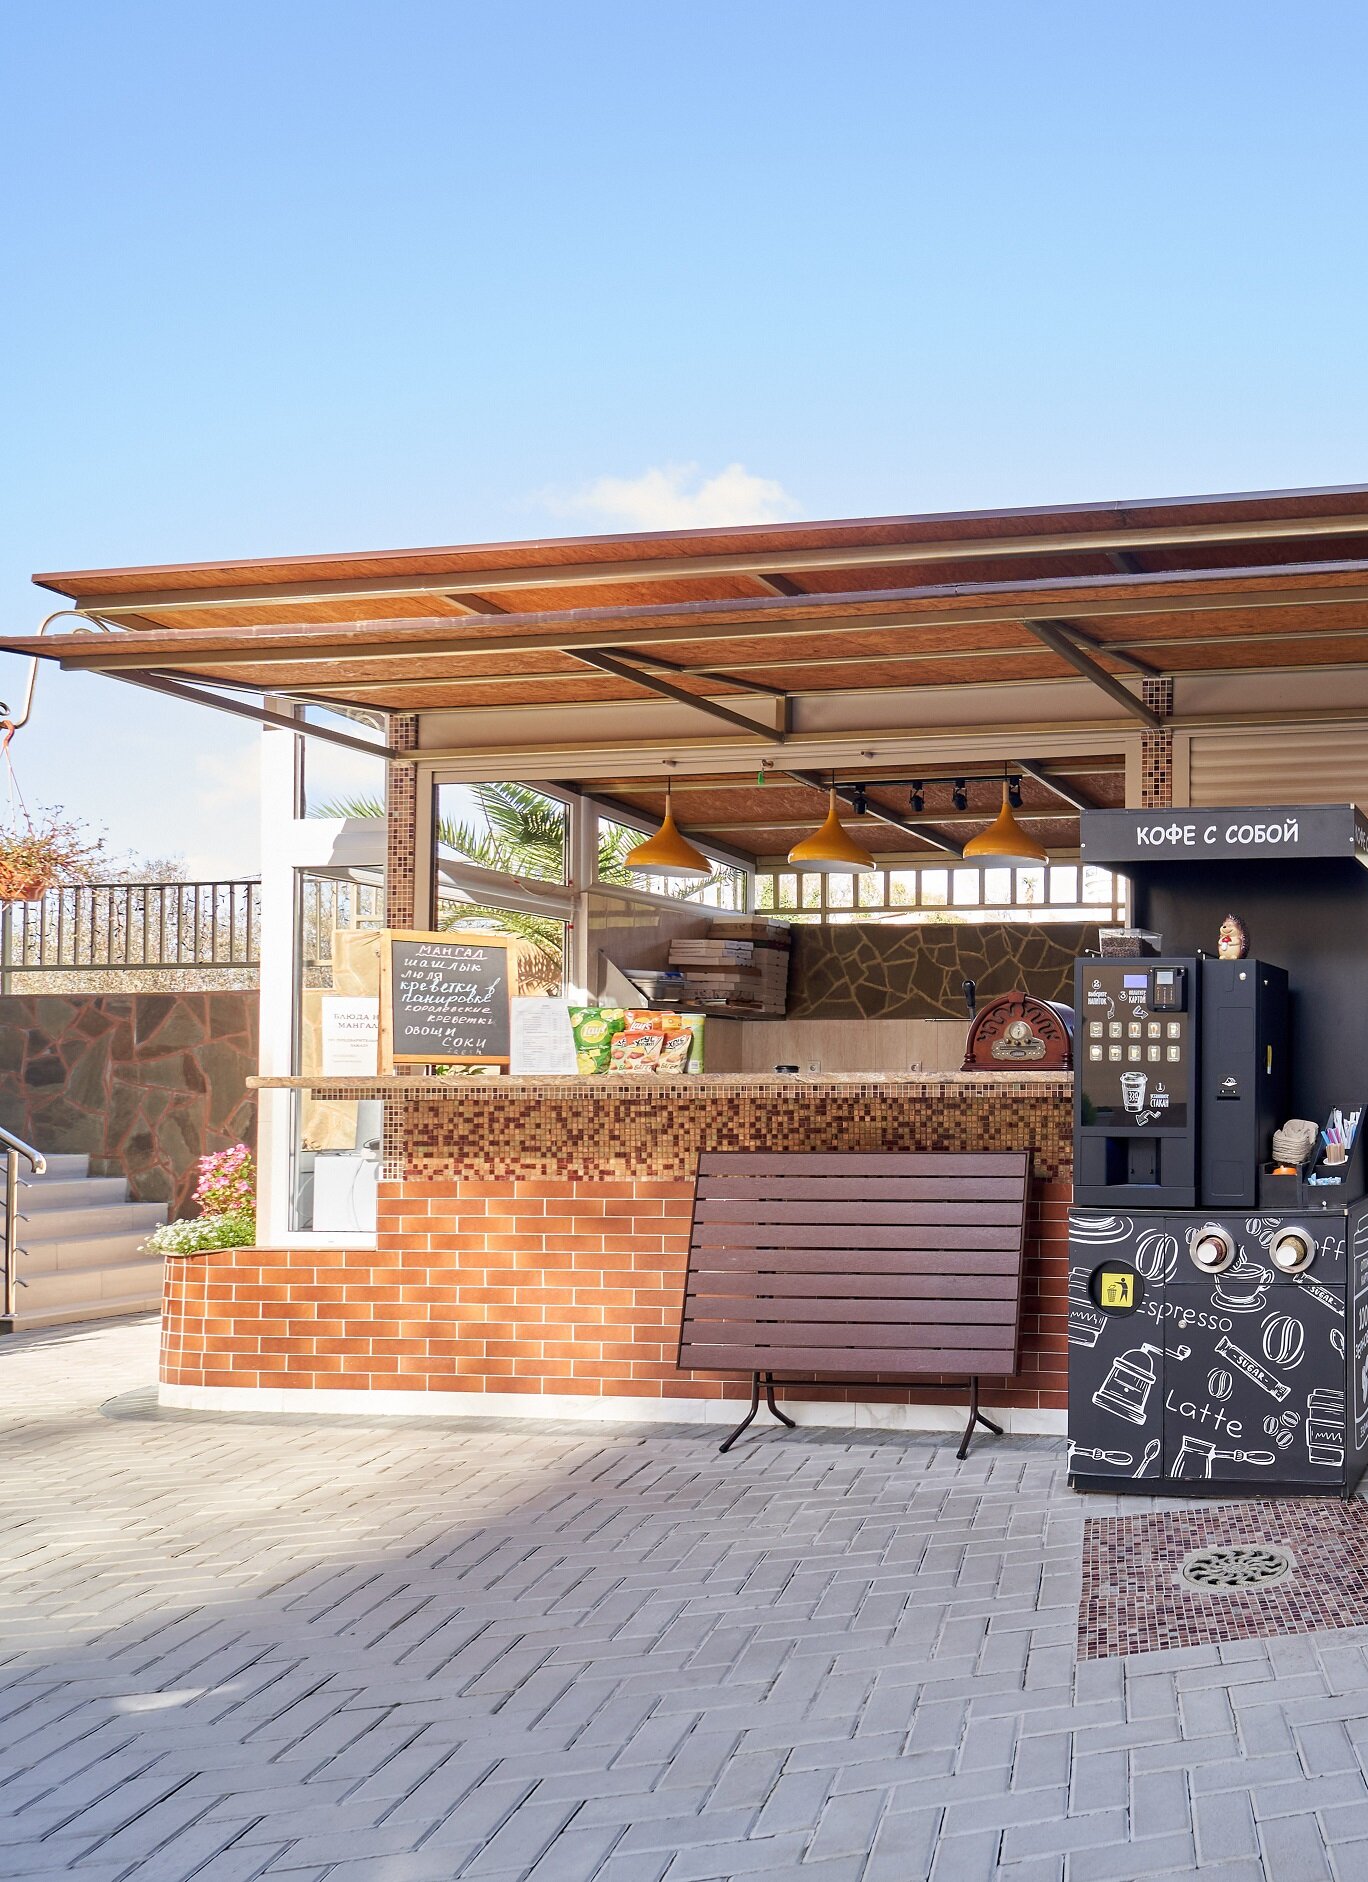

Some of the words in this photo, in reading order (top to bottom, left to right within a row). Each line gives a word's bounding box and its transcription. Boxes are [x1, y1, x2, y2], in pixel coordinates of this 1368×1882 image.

[1136, 823, 1196, 845] КОФЕ
[1203, 825, 1217, 844] С
[1225, 818, 1299, 844] СОБОЙ
[419, 945, 484, 958] МАНГАЛ
[333, 1013, 370, 1021] БЛЮДА
[441, 1036, 487, 1048] СОКИ
[1165, 1389, 1243, 1438] Latte
